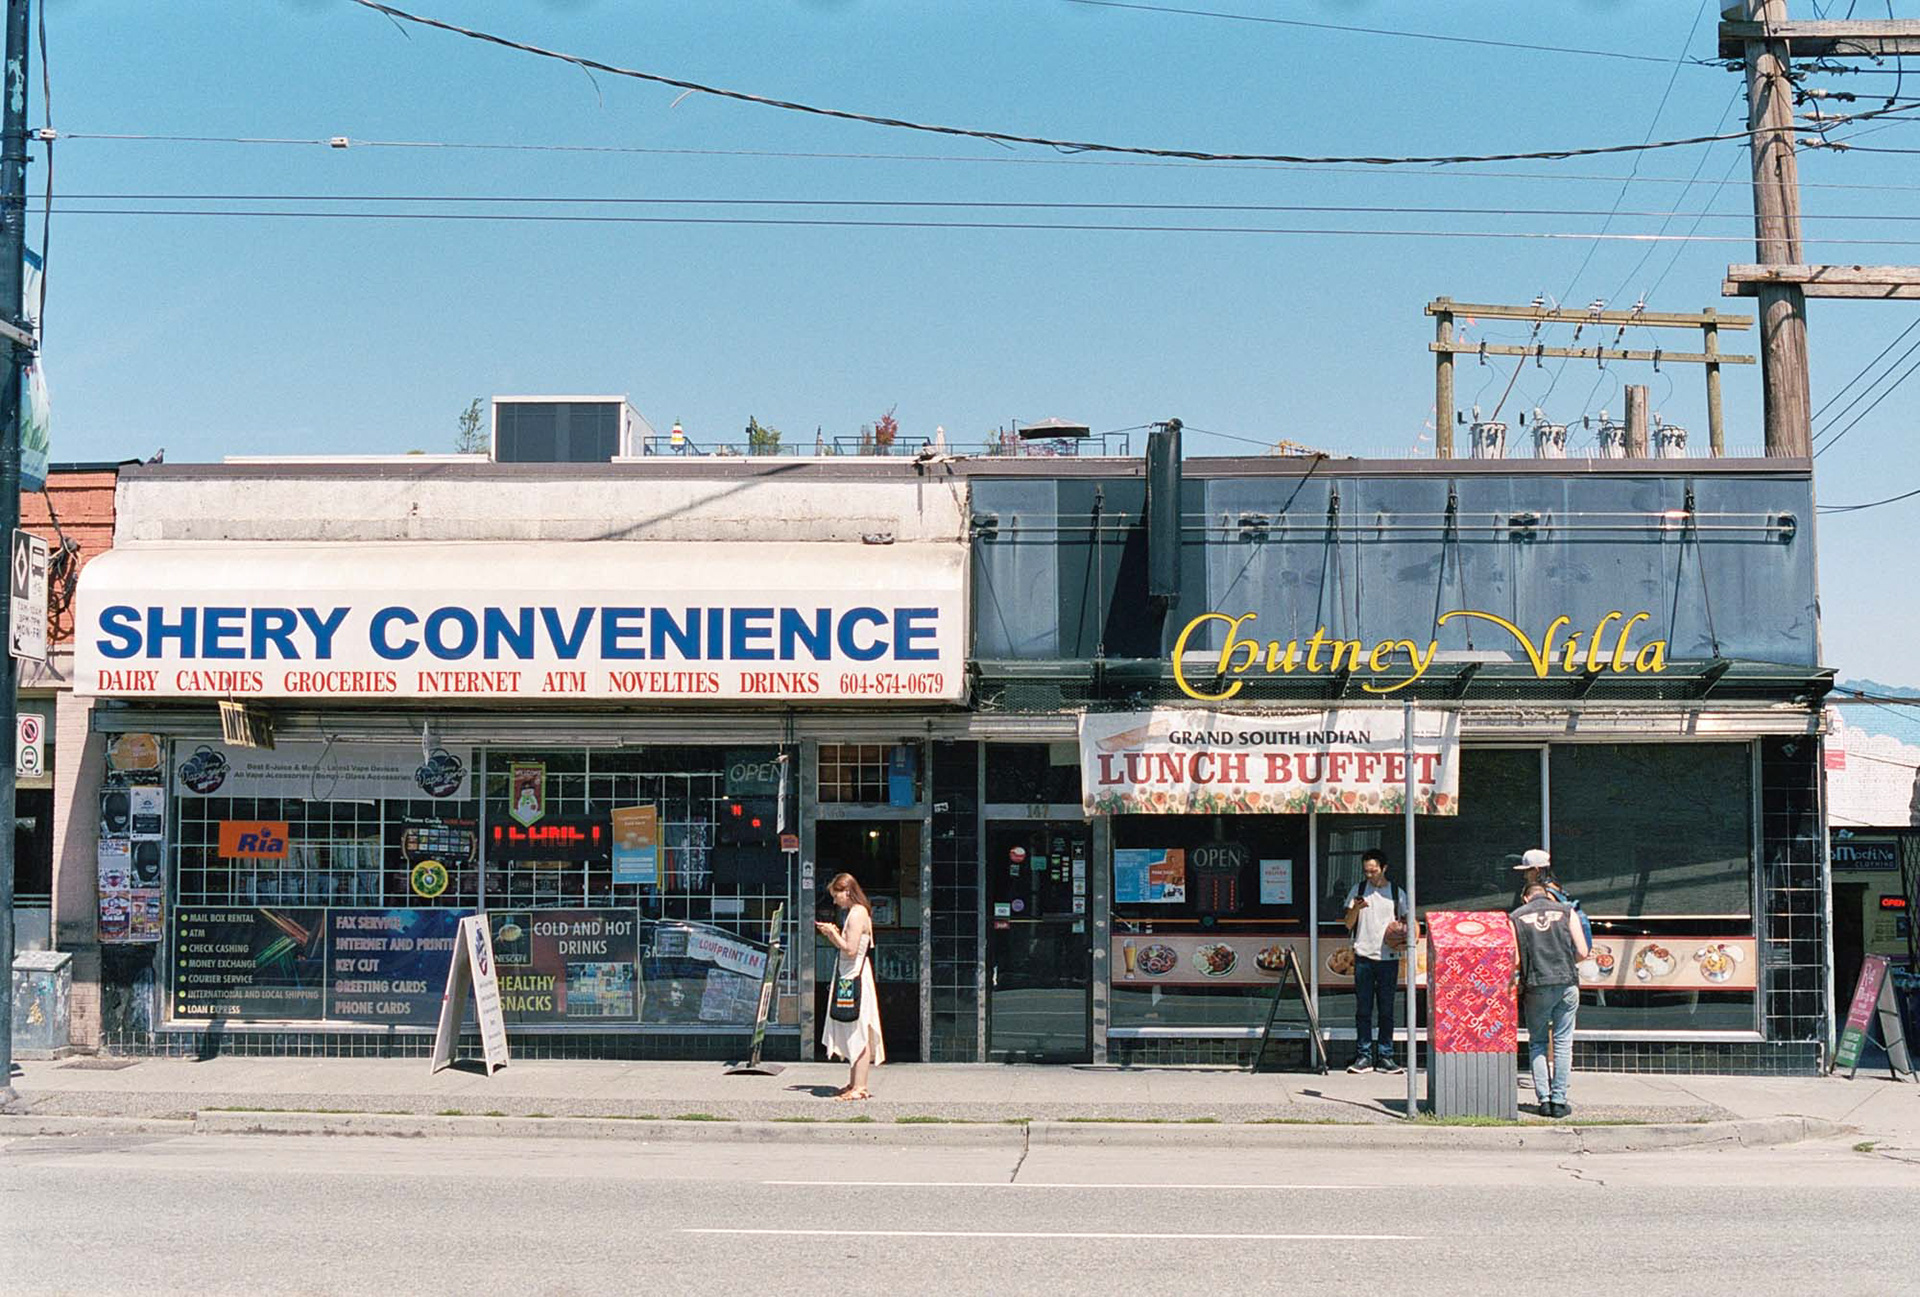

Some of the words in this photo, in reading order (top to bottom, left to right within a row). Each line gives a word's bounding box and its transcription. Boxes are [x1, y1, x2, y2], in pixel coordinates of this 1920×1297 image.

[98, 606, 348, 661] SHERY
[370, 606, 938, 661] CONVENIENCE
[1173, 612, 1437, 701] Chutney
[1437, 609, 1667, 679] Villa
[99, 671, 155, 692] DAIRY
[176, 671, 263, 692] CANDIES
[284, 671, 397, 692] GROCERIES
[418, 671, 521, 693] INTERNET
[544, 671, 585, 692] ATM
[609, 671, 720, 693] NOVELTIES
[741, 671, 819, 693] DRINKS
[840, 673, 944, 693] 604-874-0679
[1168, 730, 1234, 745] GRAND
[1238, 730, 1301, 745] SOUTH
[1305, 729, 1370, 745] INDIAN
[1097, 752, 1249, 786] LUNCH
[1264, 752, 1443, 786] BUFFET
[237, 827, 285, 854] Ria
[1193, 847, 1242, 867] OPEN
[189, 914, 209, 923] MAIL
[210, 914, 226, 923] BOX
[227, 914, 255, 923] RENTAL
[336, 916, 357, 930] FAX
[188, 929, 206, 938] ATM
[534, 921, 568, 936] COLD
[572, 921, 601, 936] AND
[605, 921, 632, 936] HOT
[188, 944, 214, 953] CHECK
[215, 944, 249, 953] CASHING
[335, 937, 389, 951] INTERNET
[390, 937, 414, 951] AND
[416, 937, 456, 951] PRINTI
[559, 940, 608, 955] DRINKS
[188, 959, 216, 969] MONEY
[217, 959, 257, 969] EXCHANGE
[335, 959, 355, 971] KEY
[357, 959, 380, 971] CUT
[187, 975, 222, 984] COURIER
[223, 975, 253, 984] SERVICE
[335, 980, 389, 993] GREETING
[391, 980, 428, 993] CARDS
[497, 975, 556, 991] HEALTHY
[187, 990, 243, 999] INTERNATIONAL
[244, 990, 260, 999] AND
[261, 990, 283, 999] LOCAL
[284, 990, 319, 999] SHIPPING
[187, 1005, 208, 1014] LOAN
[209, 1005, 241, 1014] EXPRESS
[334, 1002, 374, 1014] PHONE
[376, 1002, 412, 1014] CARDS
[500, 995, 553, 1011] SNACKS
